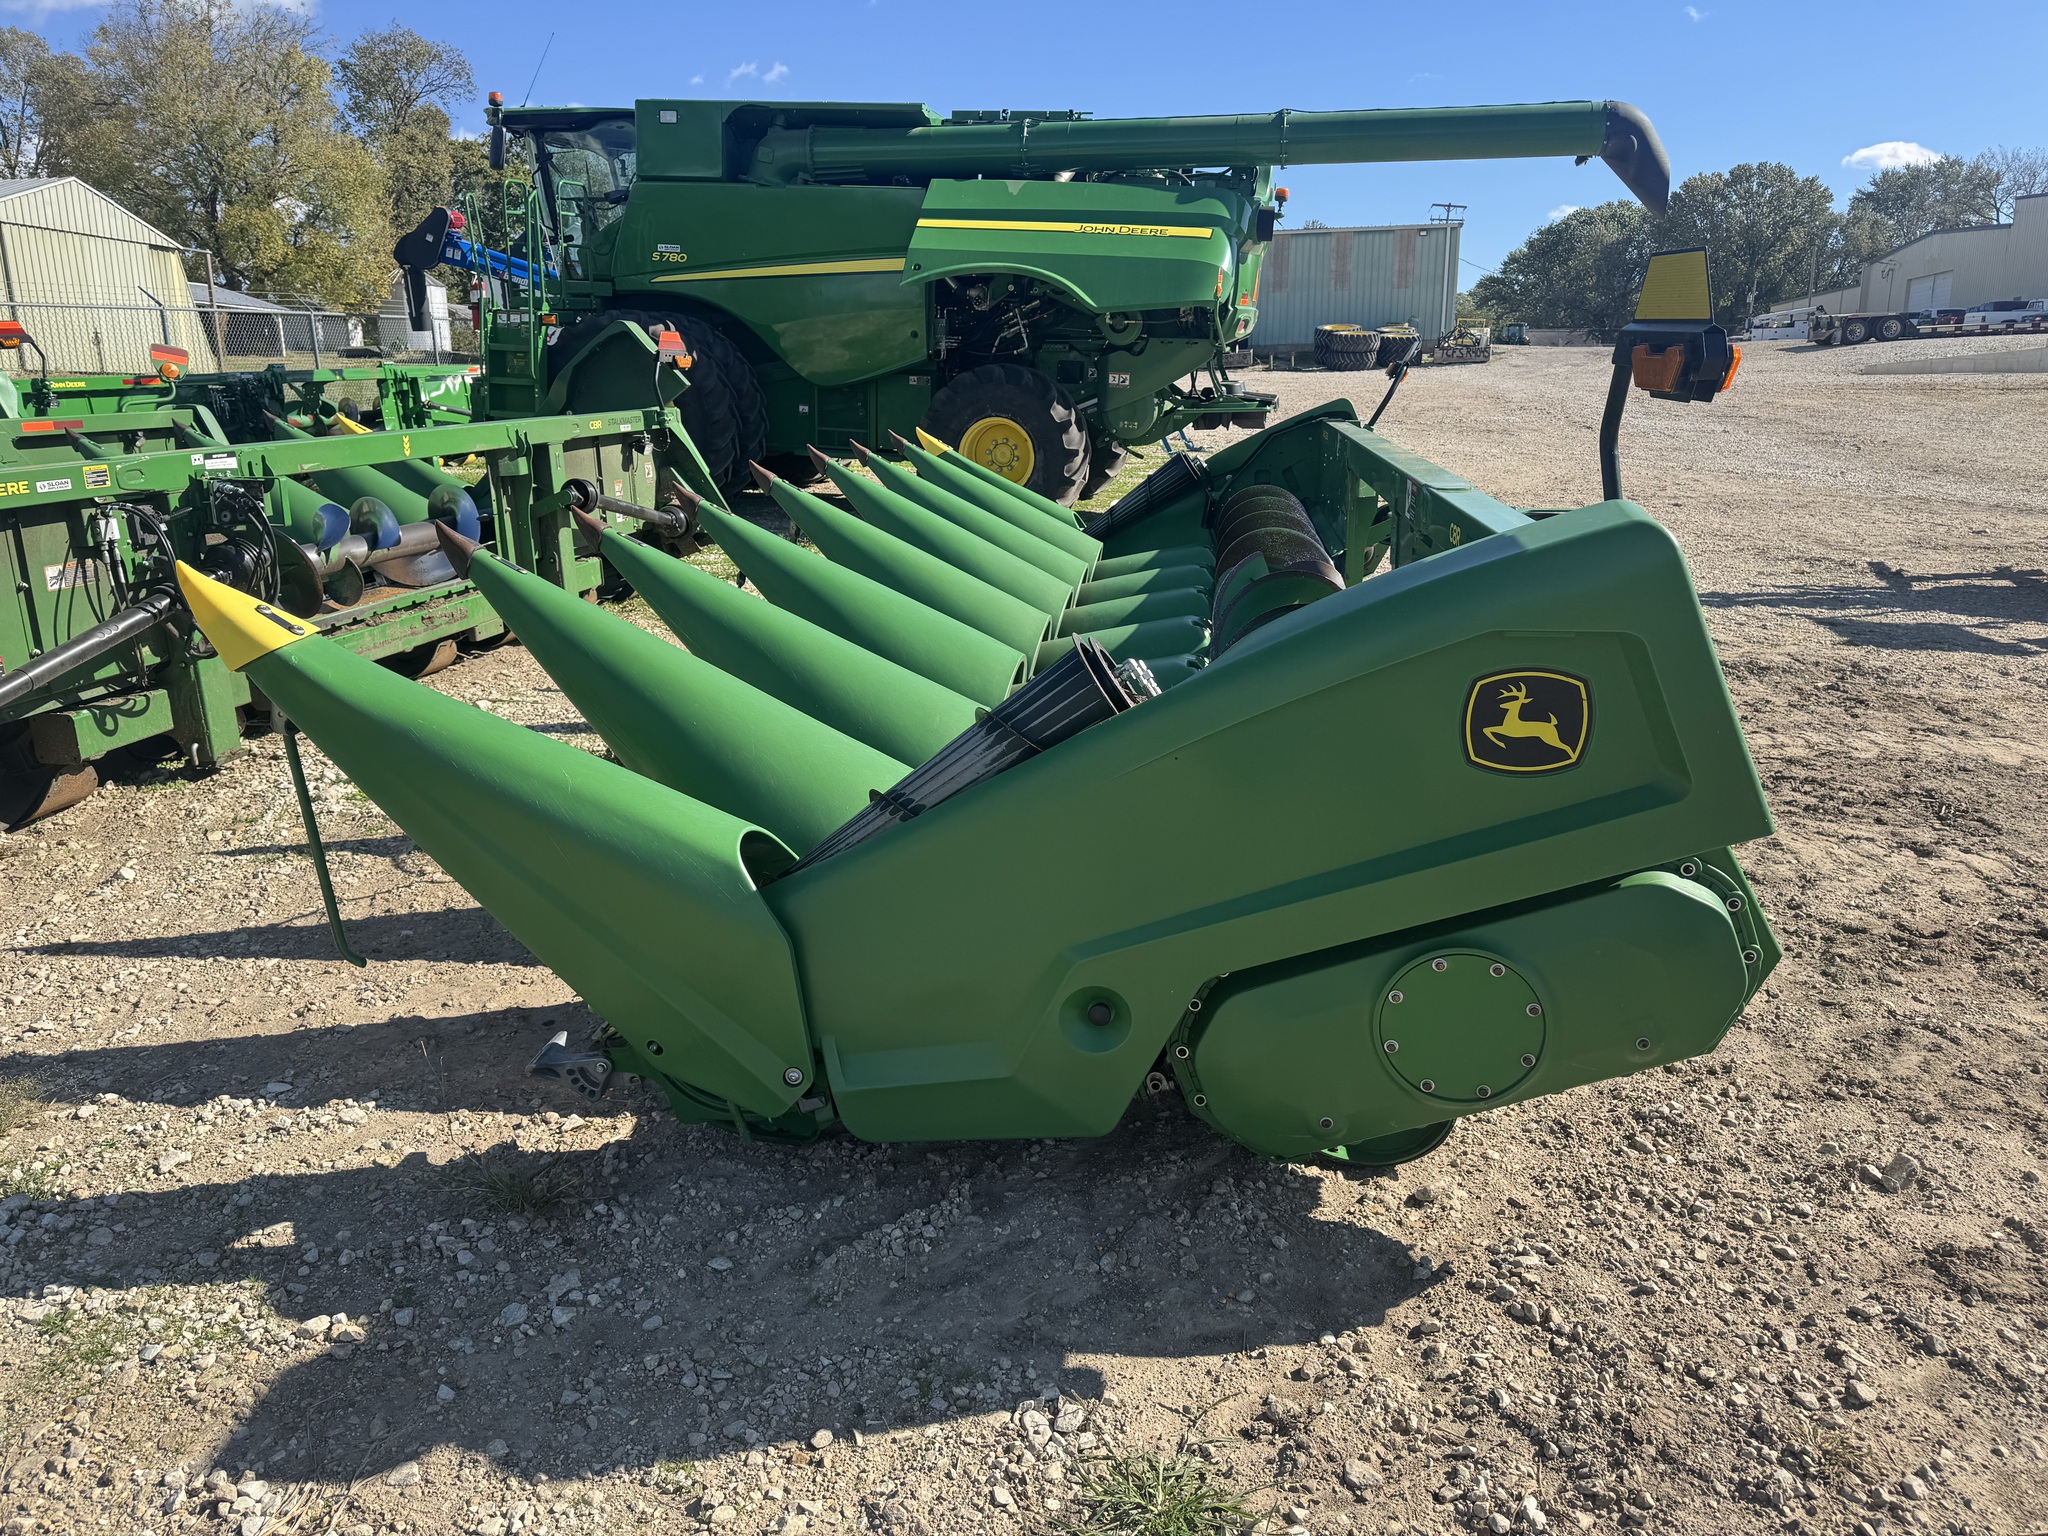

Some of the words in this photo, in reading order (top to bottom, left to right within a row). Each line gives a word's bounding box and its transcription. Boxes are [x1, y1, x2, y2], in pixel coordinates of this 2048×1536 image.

[1074, 225, 1115, 233] JOHN
[1119, 226, 1169, 235] DEERE
[652, 252, 688, 263] S780
[47, 479, 69, 488] SLOAN
[1450, 523, 1461, 546] C8R
